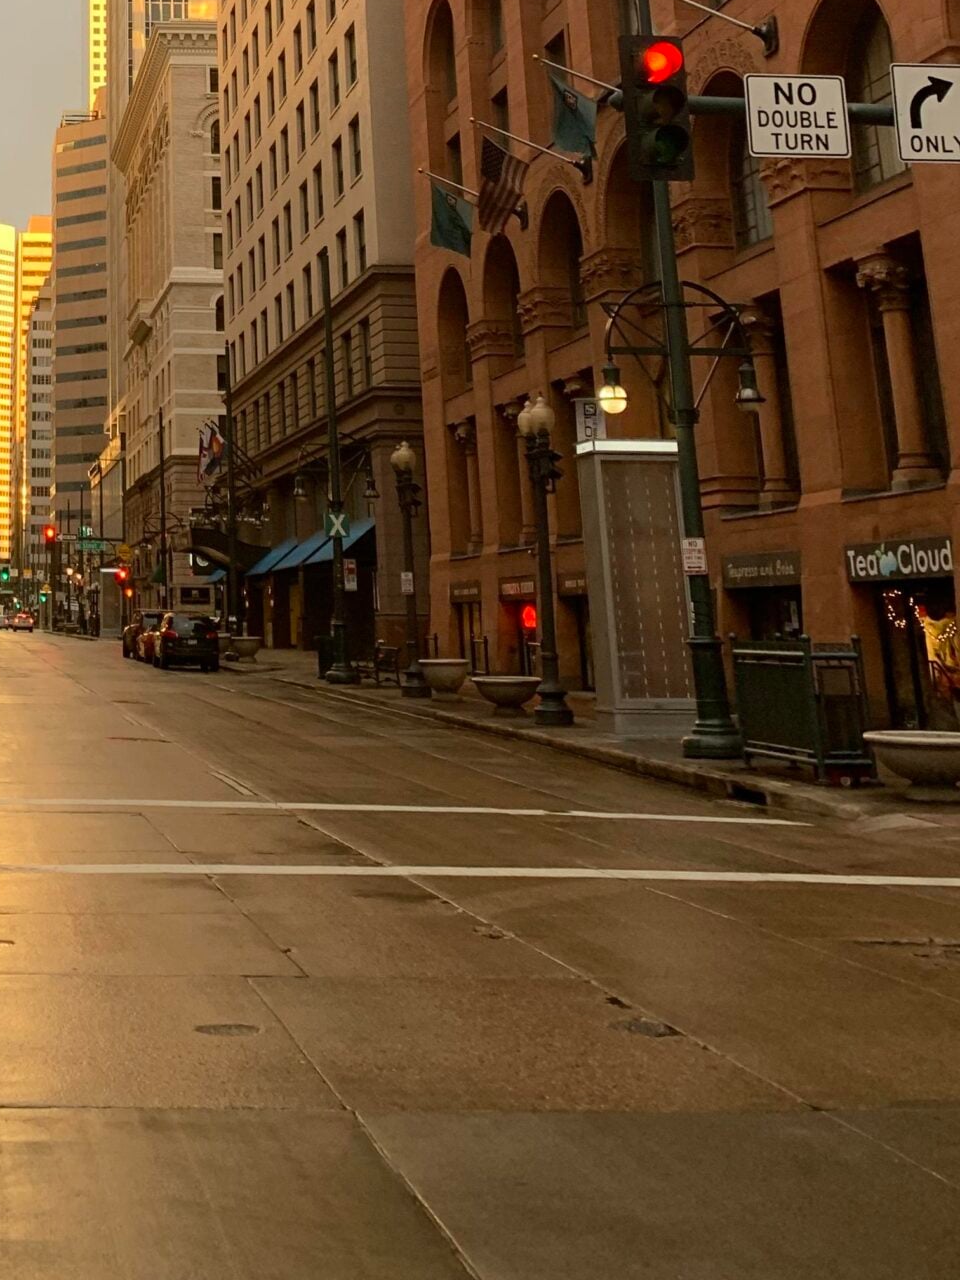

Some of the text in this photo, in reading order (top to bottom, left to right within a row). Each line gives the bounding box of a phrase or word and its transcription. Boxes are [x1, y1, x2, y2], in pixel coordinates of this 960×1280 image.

[773, 82, 817, 105] NO
[757, 110, 838, 129] DOUBLE
[771, 132, 829, 151] TURN
[847, 540, 953, 577] Tea Cloud
